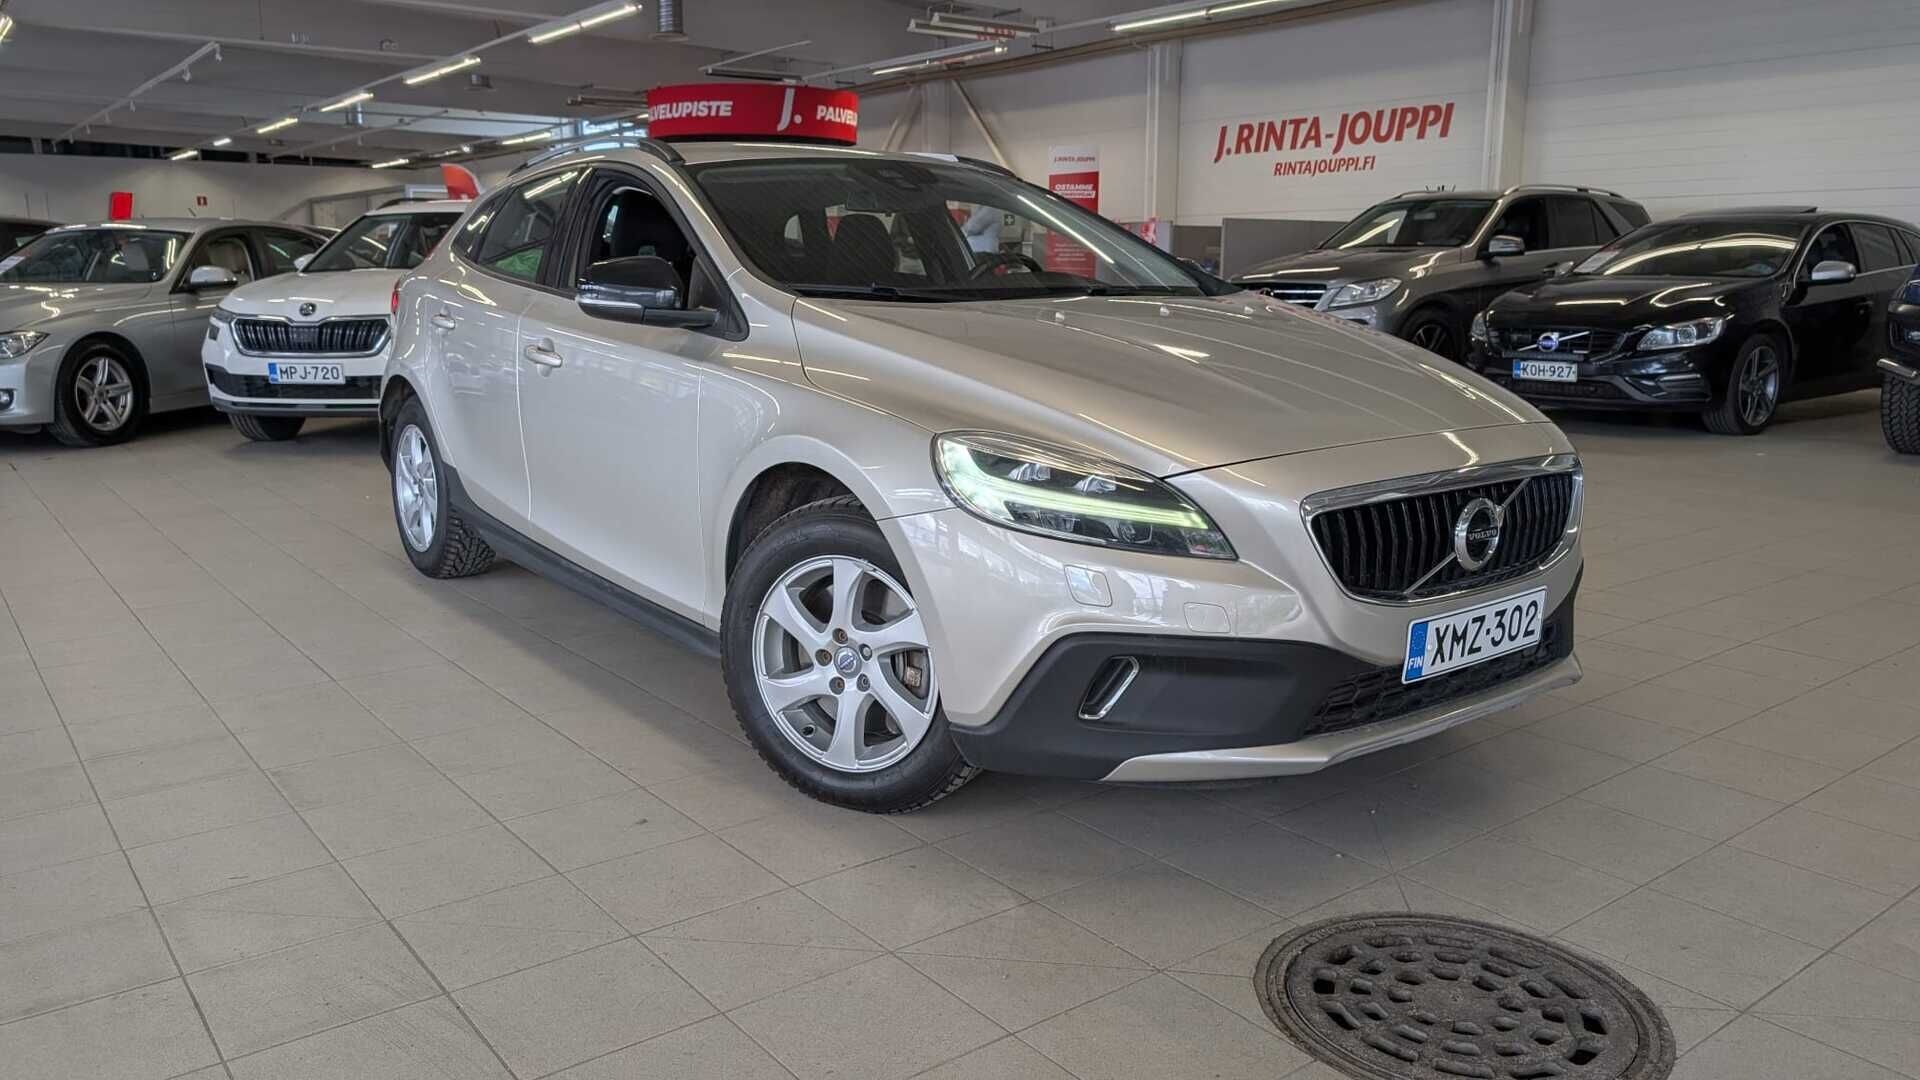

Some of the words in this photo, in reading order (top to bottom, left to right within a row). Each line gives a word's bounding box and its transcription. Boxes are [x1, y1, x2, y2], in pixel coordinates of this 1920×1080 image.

[777, 87, 802, 132] J.
[1213, 102, 1455, 164] J.RINTA-JOUPPI
[1273, 155, 1376, 177] RINTAJOUPPI.FI
[279, 366, 340, 380] MPJ-720
[1520, 364, 1574, 378] KOH-927
[1468, 528, 1498, 541] VOLVO
[1430, 599, 1539, 667] XMZ-302
[1408, 655, 1424, 671] FIN
